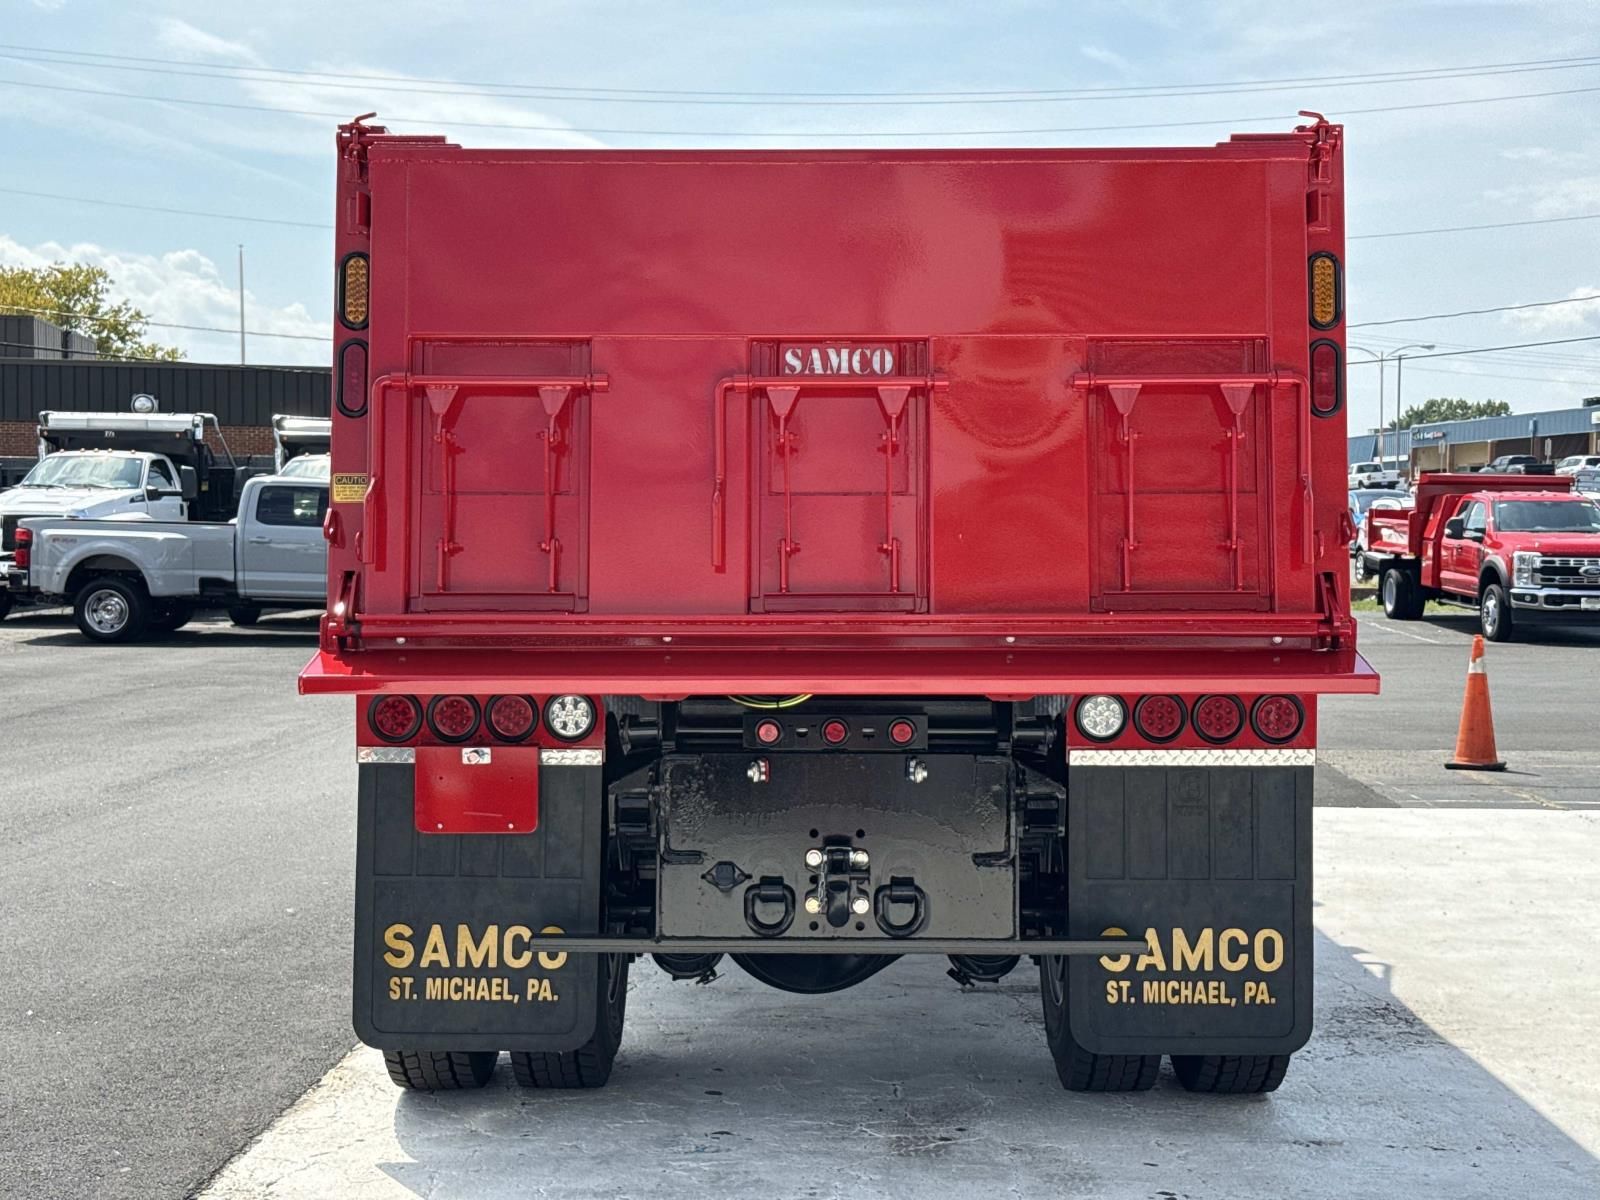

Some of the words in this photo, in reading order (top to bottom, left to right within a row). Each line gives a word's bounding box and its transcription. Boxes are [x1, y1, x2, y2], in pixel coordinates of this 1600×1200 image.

[784, 348, 894, 375] SAMCO
[335, 476, 368, 485] CAUTIO
[383, 923, 568, 970] SAMCO
[389, 976, 418, 1001] ST.
[426, 977, 520, 1004] MICHAEL,
[526, 978, 559, 1002] PA.
[1106, 979, 1136, 1005] ST.
[1142, 980, 1237, 1007] MICHAEL,
[1244, 981, 1276, 1005] PA.
